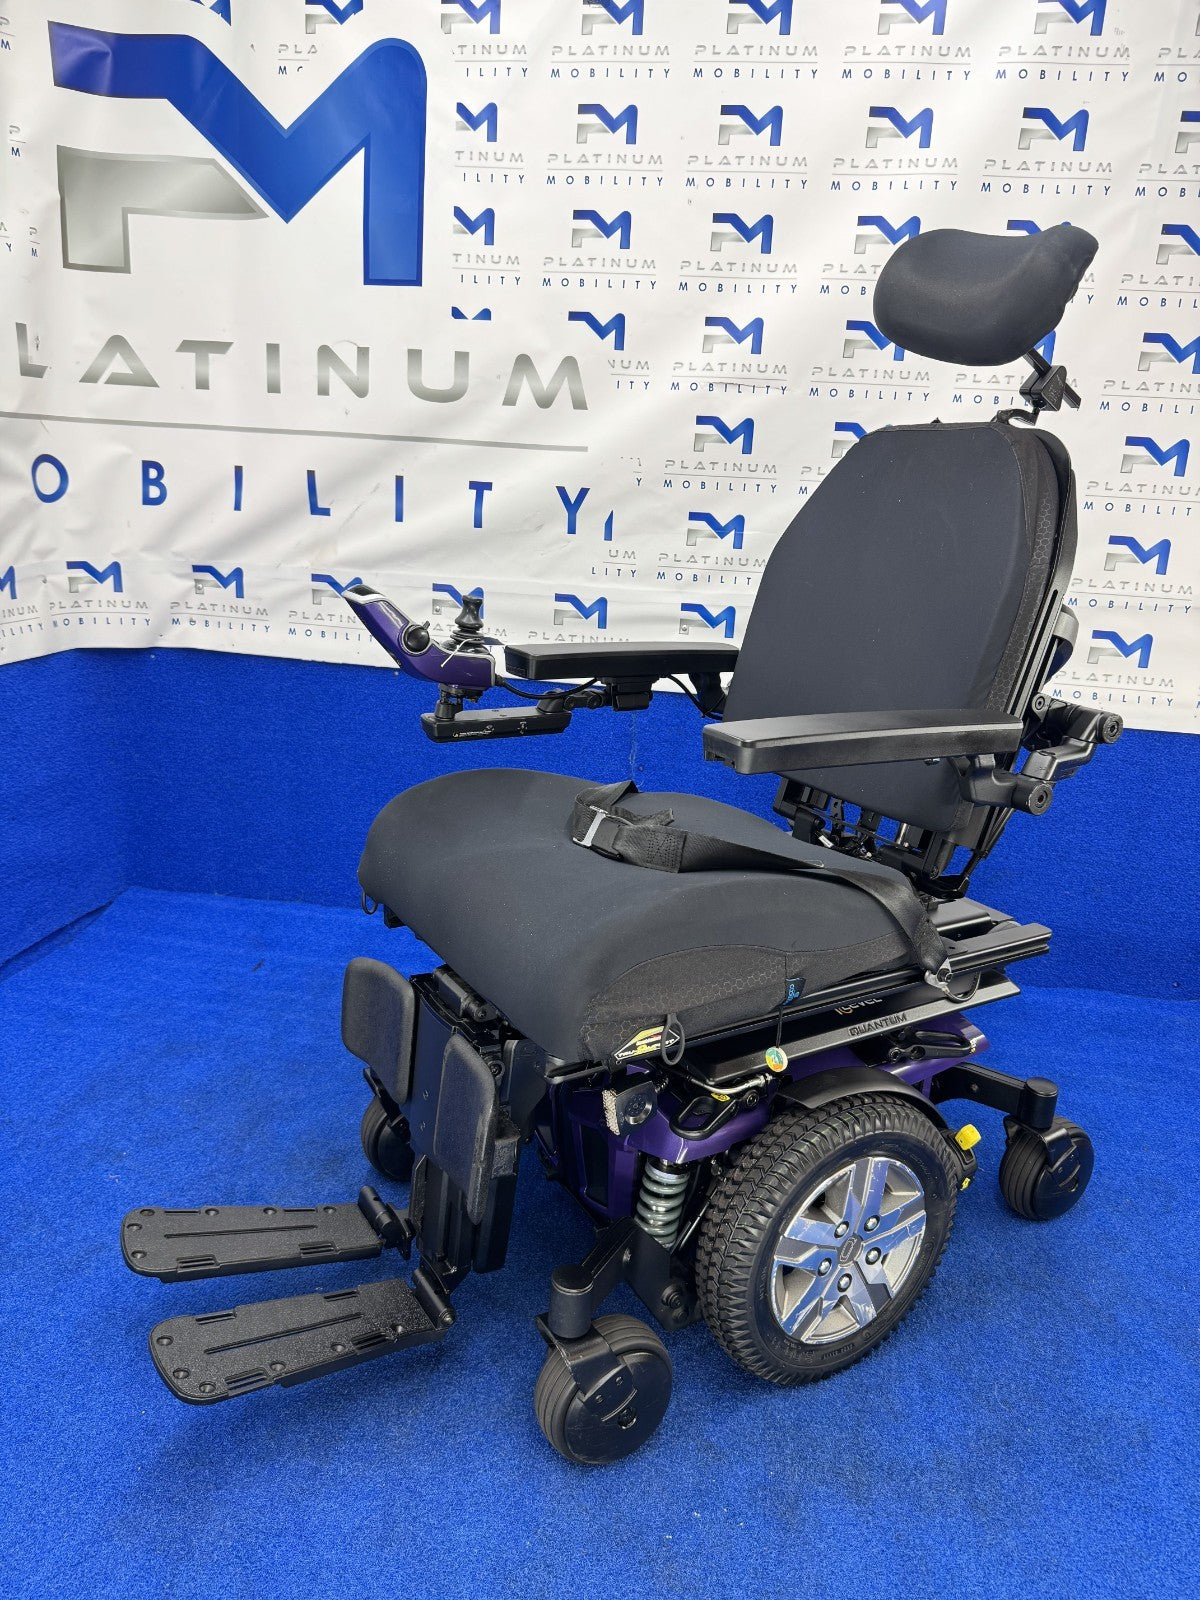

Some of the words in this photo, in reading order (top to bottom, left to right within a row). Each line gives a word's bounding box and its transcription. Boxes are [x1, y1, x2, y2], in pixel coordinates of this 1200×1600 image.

[452, 44, 528, 55] TINUM
[552, 45, 670, 57] PLATINUM
[695, 45, 818, 57] PLATINUM
[844, 45, 971, 58] PLATINUM
[999, 45, 1131, 59] PLATINUM
[551, 68, 671, 79] MOBILITY
[693, 68, 818, 79] MOBILITY
[842, 69, 971, 81] MOBILITY
[996, 69, 1130, 82] MOBILITY
[547, 153, 663, 166] PLATINUM
[688, 155, 808, 167] PLATINUM
[833, 157, 958, 169] PLATINUM
[984, 159, 1113, 173] PLATINUM
[547, 175, 664, 187] MOBILITY
[686, 178, 808, 190] MOBILITY
[831, 180, 958, 191] MOBILITY
[981, 182, 1112, 196] MOBILITY
[543, 257, 656, 270] PLATINUM
[680, 261, 797, 274] PLATINUM
[542, 277, 657, 290] MOBILITY
[678, 282, 798, 294] MOBILITY
[15, 322, 588, 411] LATINUM
[673, 361, 788, 375] PLATINUM
[811, 366, 931, 382] PLATINUM
[671, 382, 788, 396] MOBILITY
[809, 388, 930, 402] MOBILITY
[664, 459, 777, 474] PLATINUM
[663, 479, 777, 494] MOBILITY
[31, 453, 590, 535] OBILITY
[1071, 578, 1193, 595] PLATINUM
[49, 600, 149, 611] PLATINUM
[170, 601, 269, 616] PLATINUM
[1068, 597, 1192, 614] MOBILITY
[0, 623, 44, 639] ILITY
[172, 618, 270, 633] MOBILITY
[1055, 670, 1174, 688] PLATINUM
[1052, 688, 1173, 706] MOBILITY
[848, 1012, 907, 1037] QUANTUM
